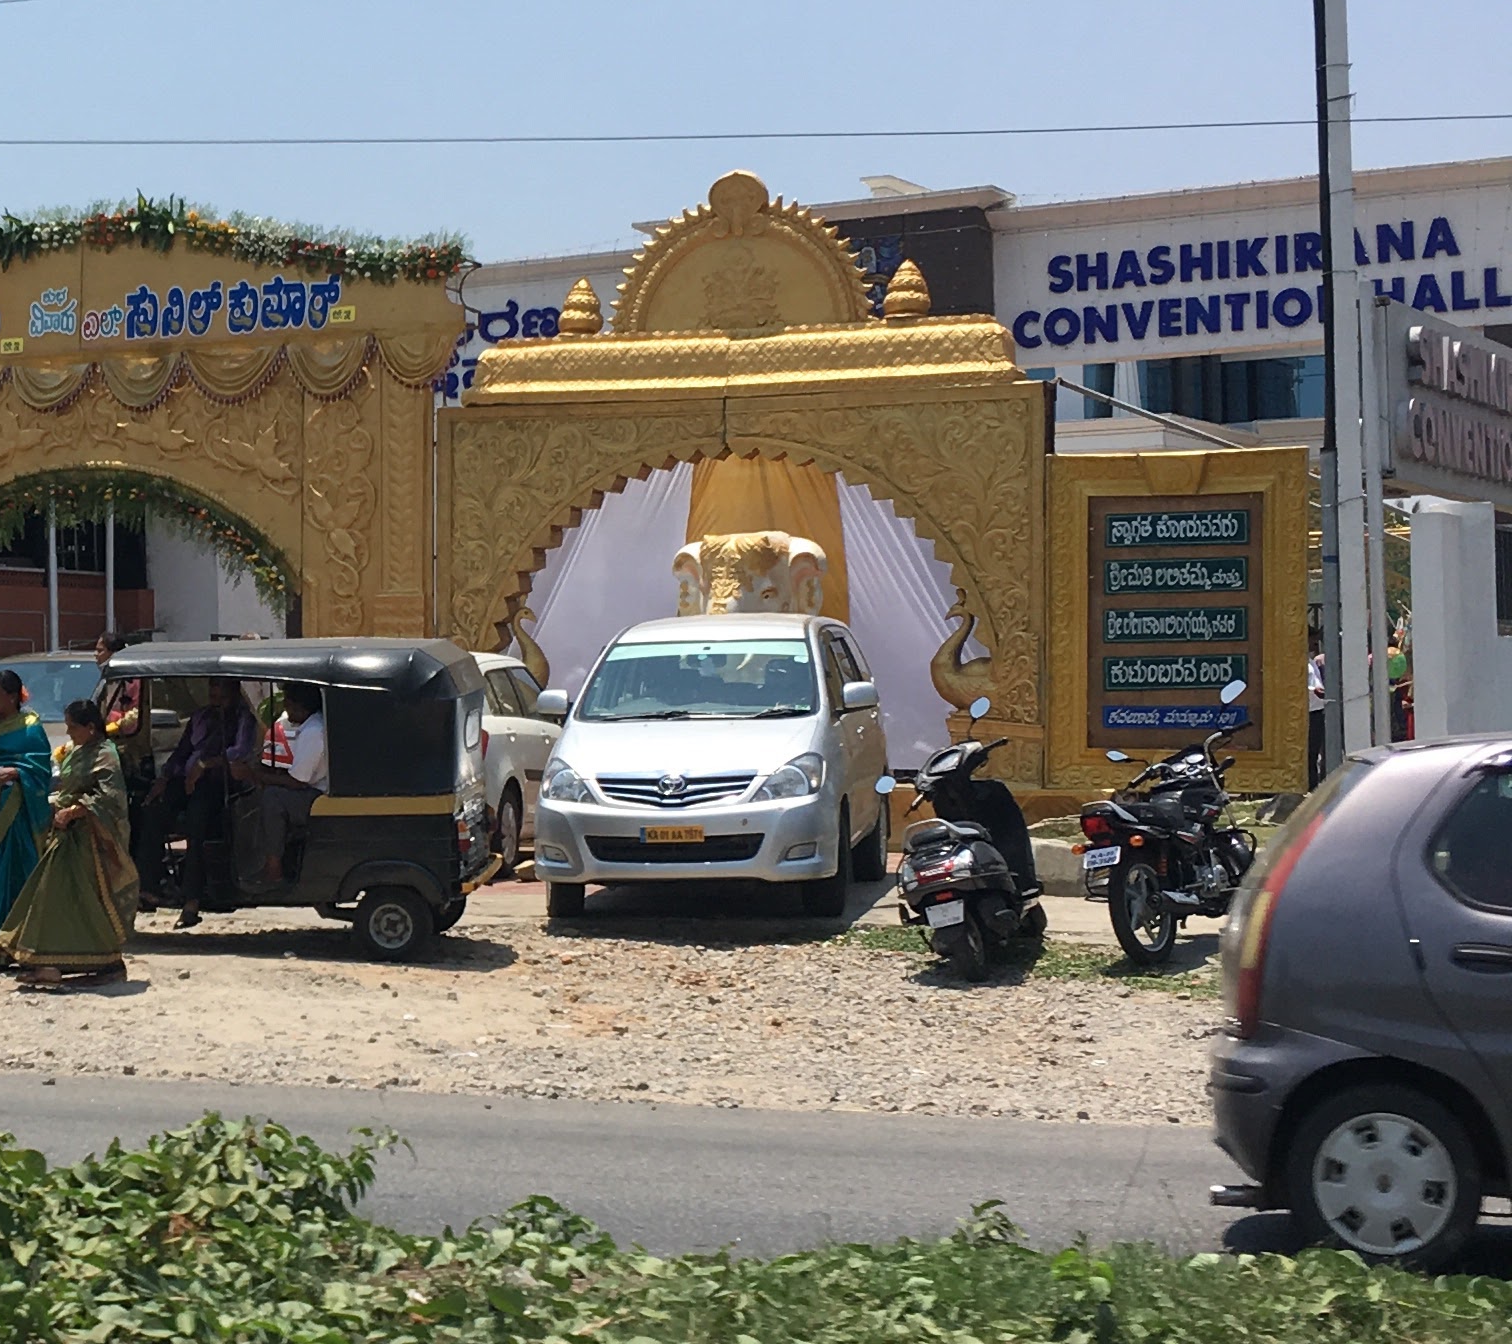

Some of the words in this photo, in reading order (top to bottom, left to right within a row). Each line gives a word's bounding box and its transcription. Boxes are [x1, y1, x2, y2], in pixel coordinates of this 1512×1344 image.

[125, 280, 223, 340] ಸುನಿಲ್
[227, 274, 343, 336] ಕುಮಾರ್
[1012, 285, 1325, 350] CONVENTIO
[1156, 513, 1239, 539] ಕೋರುವವರು
[1110, 562, 1153, 591] ಶ್ರೀಮತಿ
